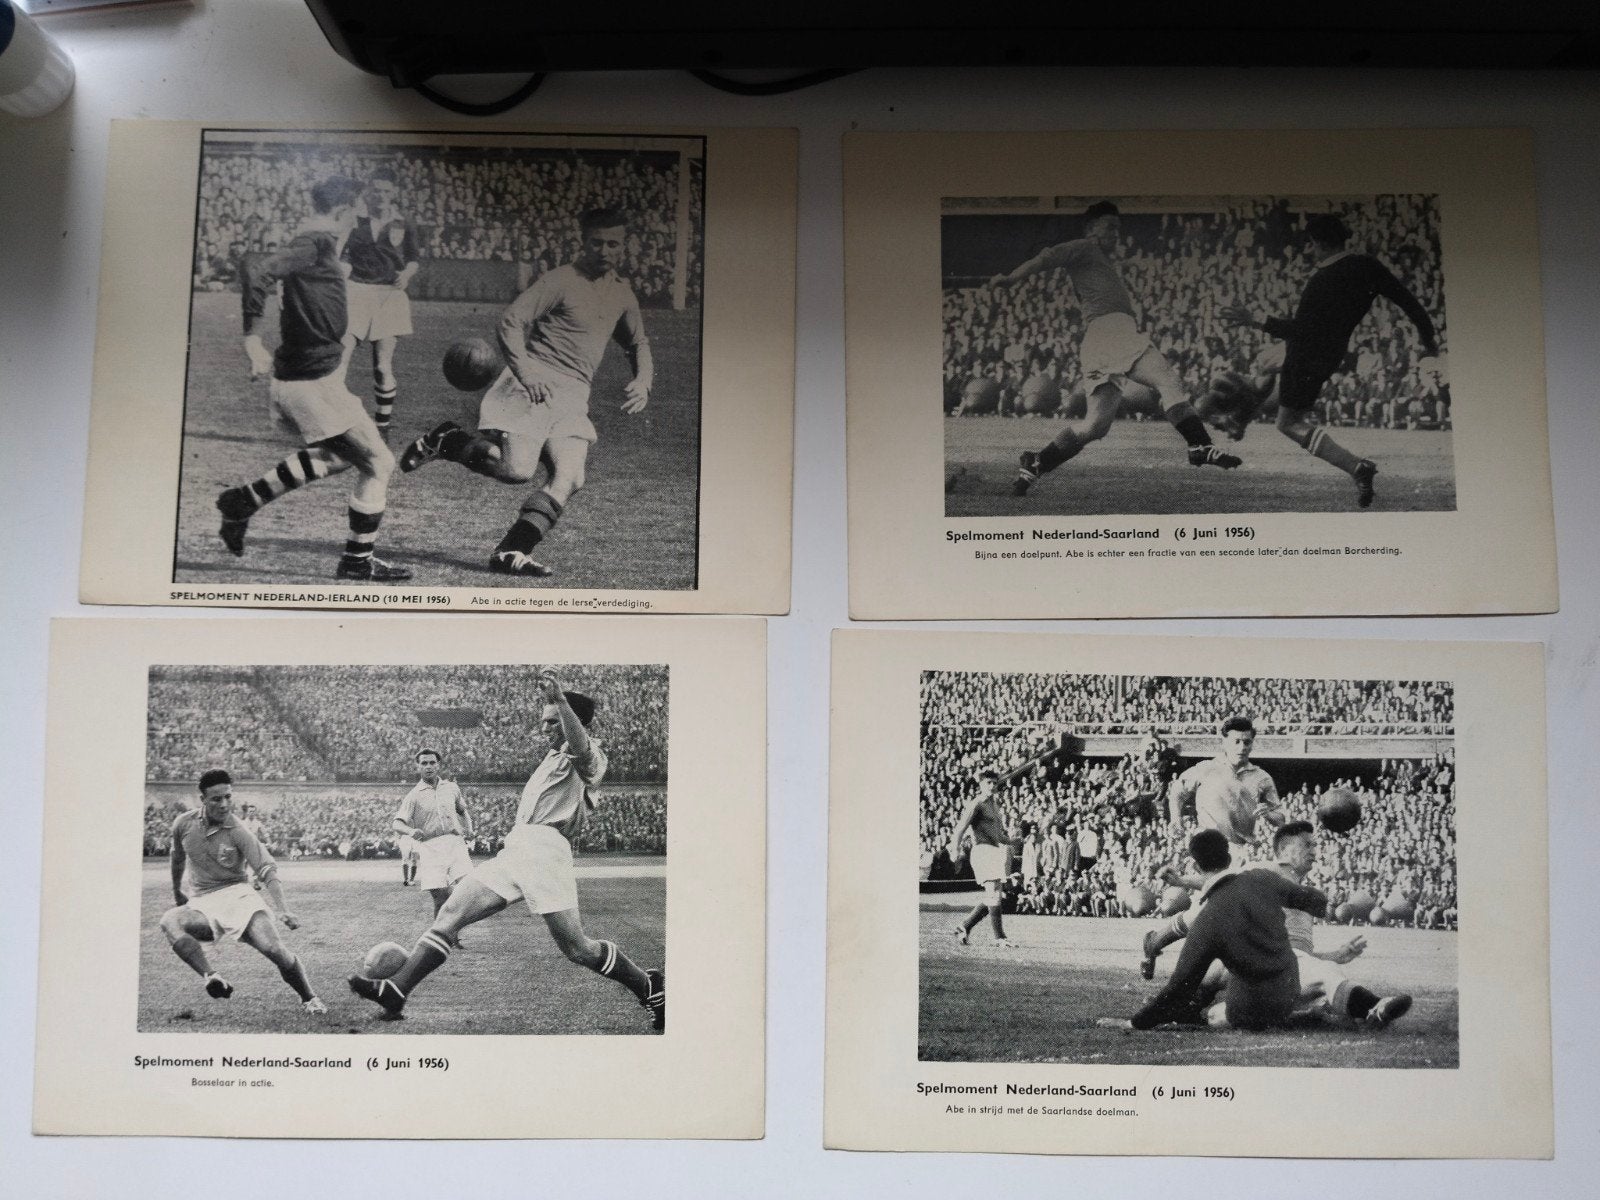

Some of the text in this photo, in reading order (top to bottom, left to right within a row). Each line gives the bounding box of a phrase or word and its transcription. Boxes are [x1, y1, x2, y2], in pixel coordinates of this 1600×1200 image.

[945, 526, 1257, 545] Spelmoment Nederland-Saarland (6 Juni 1956)
[974, 545, 1403, 561] Bijna een doelpunt. Abe is echter een fractie van een seconde later dan doelman Borcherding.
[169, 591, 251, 602] SPELMOMENT
[253, 592, 381, 604] NEDERLAND-IERLAND
[382, 594, 399, 605] (10
[401, 594, 423, 605] MEI
[426, 594, 452, 607] 1956)
[470, 596, 491, 606] Abe
[492, 596, 503, 606] in
[504, 596, 528, 607] actie
[529, 597, 555, 609] tegen
[557, 597, 570, 608] de
[597, 597, 654, 611] verdediging.
[133, 1054, 451, 1073] Spelmoment Nederland-Saarland (6 Juni 1956)
[191, 1077, 276, 1088] Bosselaar in actie.
[916, 1081, 1237, 1102] Spelmoment Nederland-Saarland (6 Juni 1956)
[945, 1103, 1140, 1118] Abe in strijd met de Saarlandse doelman.
